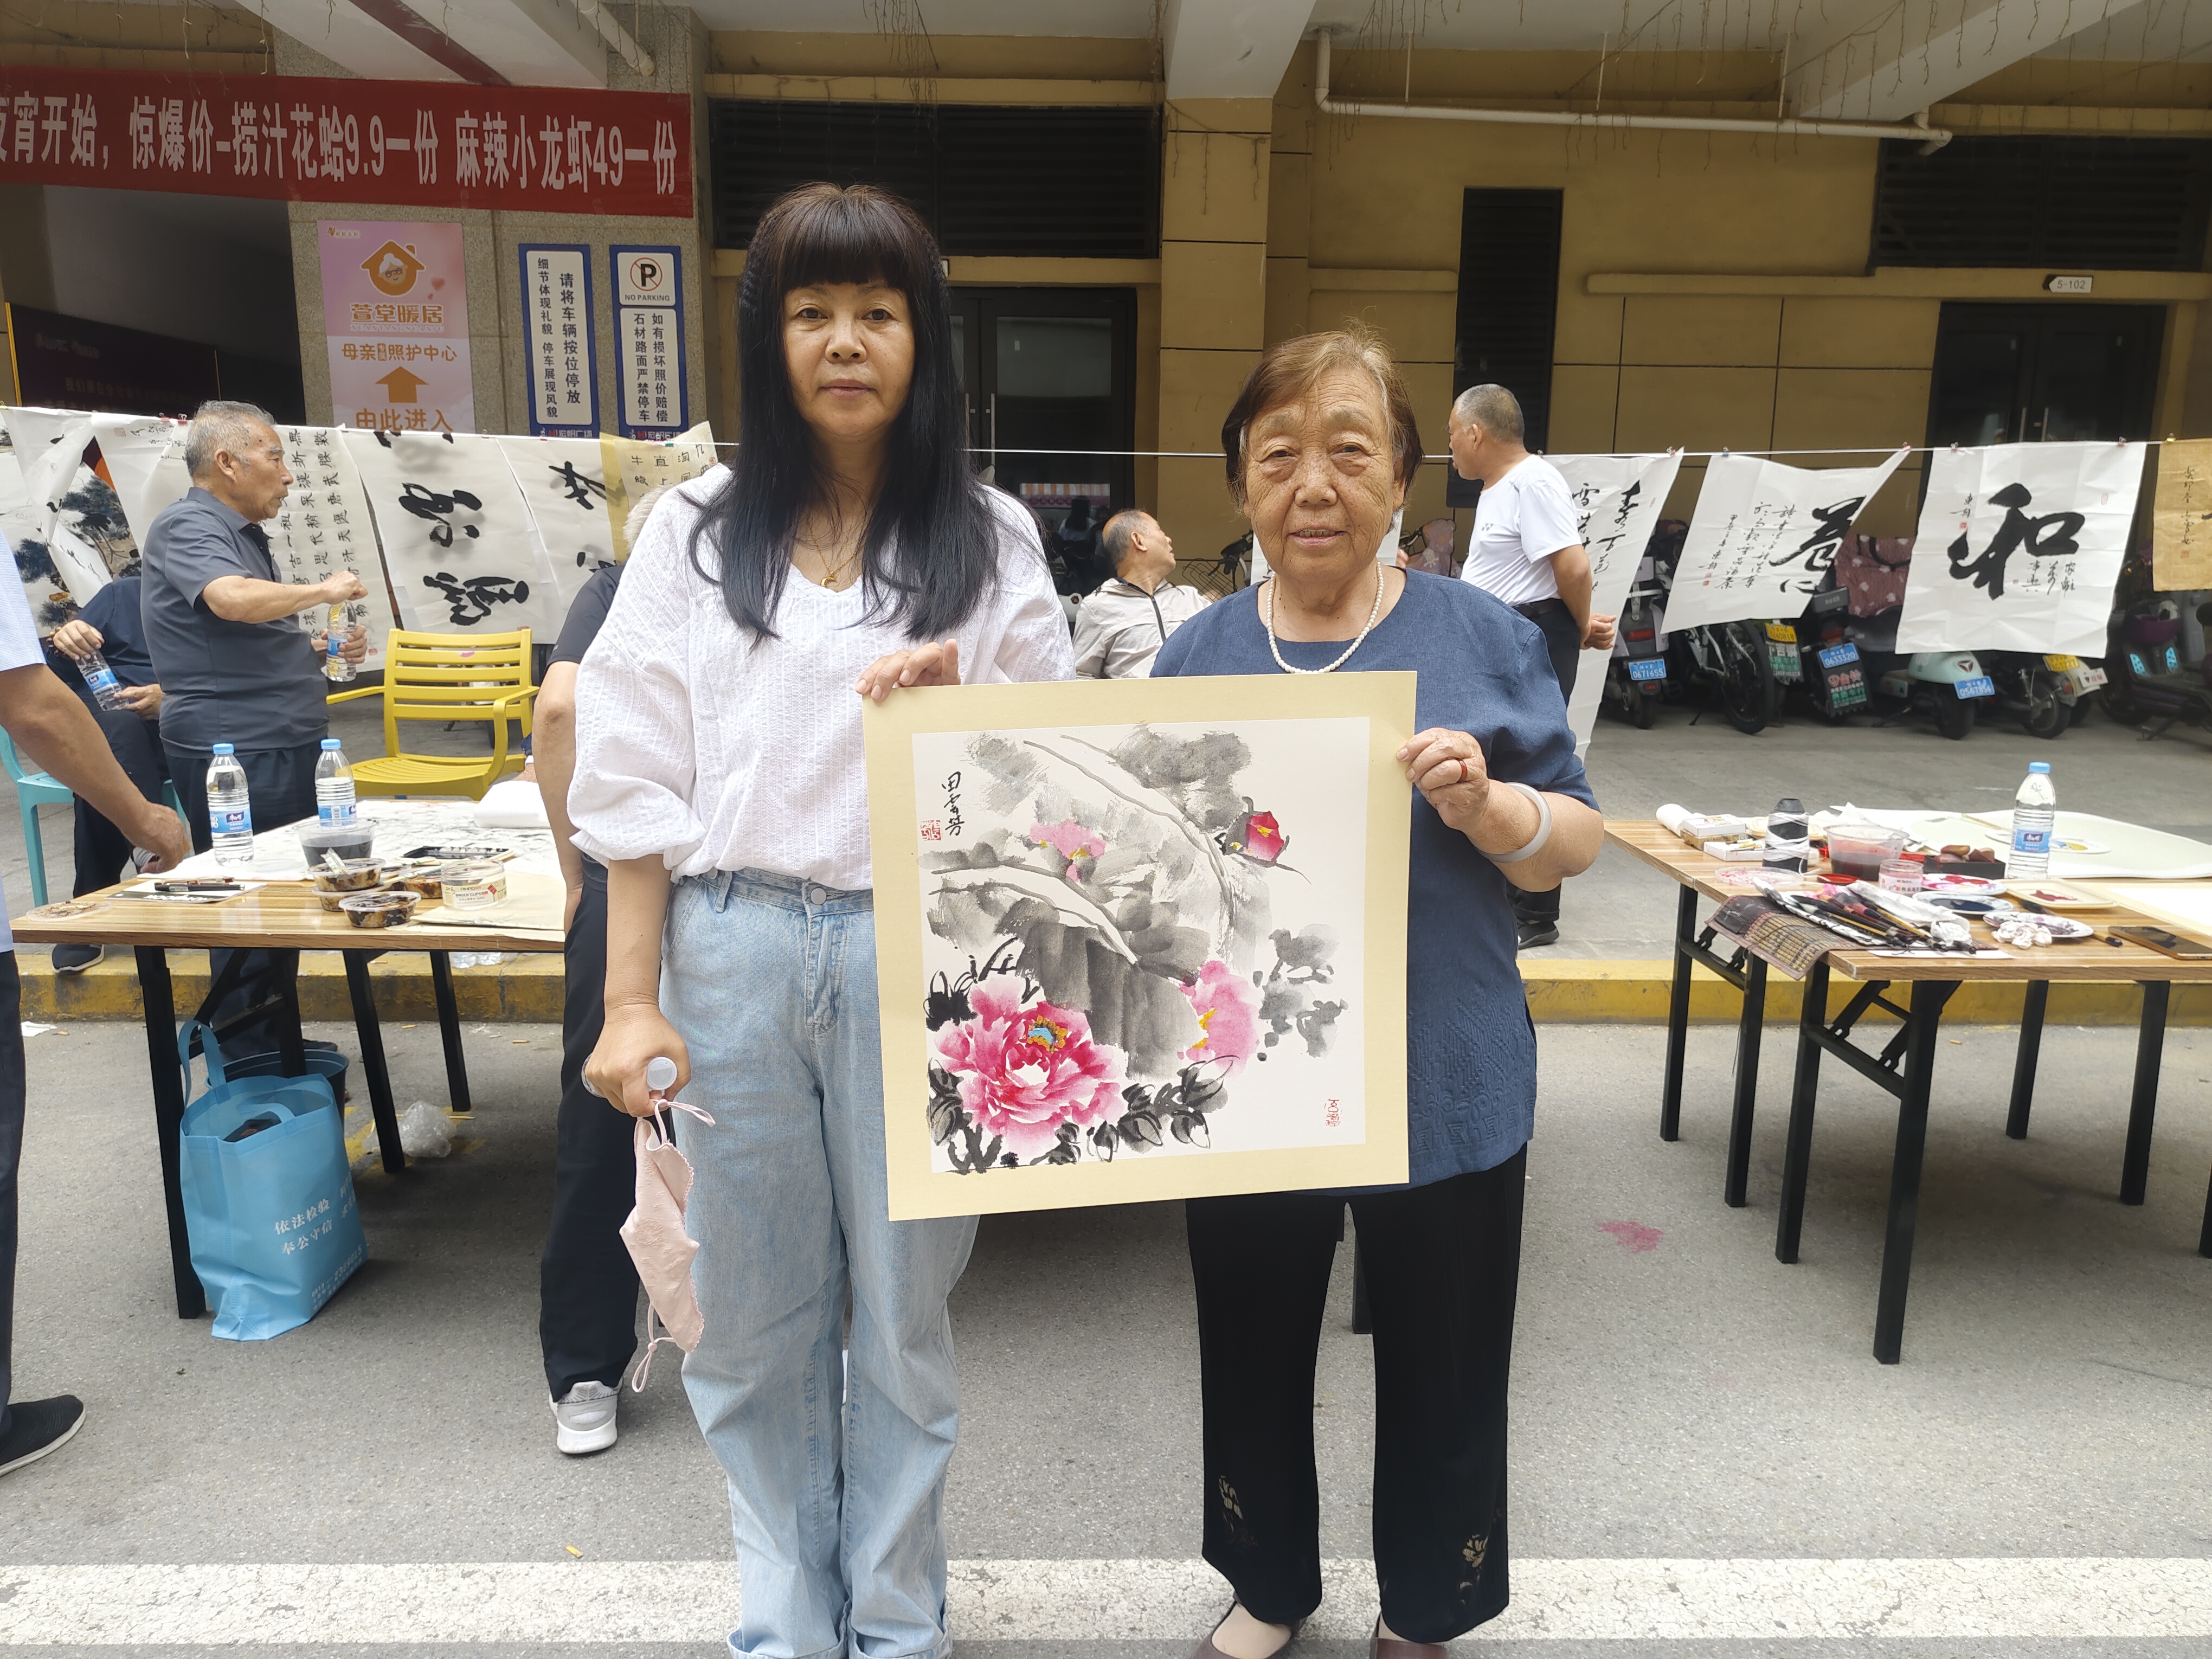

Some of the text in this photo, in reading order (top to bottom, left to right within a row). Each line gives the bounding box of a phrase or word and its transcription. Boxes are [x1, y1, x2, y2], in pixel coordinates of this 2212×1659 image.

[455, 110, 677, 195] 麻辣小龙虾49一份
[351, 304, 442, 324] 萱堂暖居
[2056, 280, 2086, 290] 5-102
[537, 258, 558, 418] 细节体现礼貌 停车展现风貌
[560, 273, 581, 404] 请将车辆按位停放
[634, 313, 650, 422] 石材路面严禁停车
[652, 313, 668, 422] 如有损坏照价赔偿
[356, 408, 453, 432] 由此进入
[1947, 483, 2085, 600] 和
[1632, 668, 1664, 679] 0671655
[274, 1198, 331, 1236] 依法检验
[281, 1219, 334, 1256] 奉公守信
